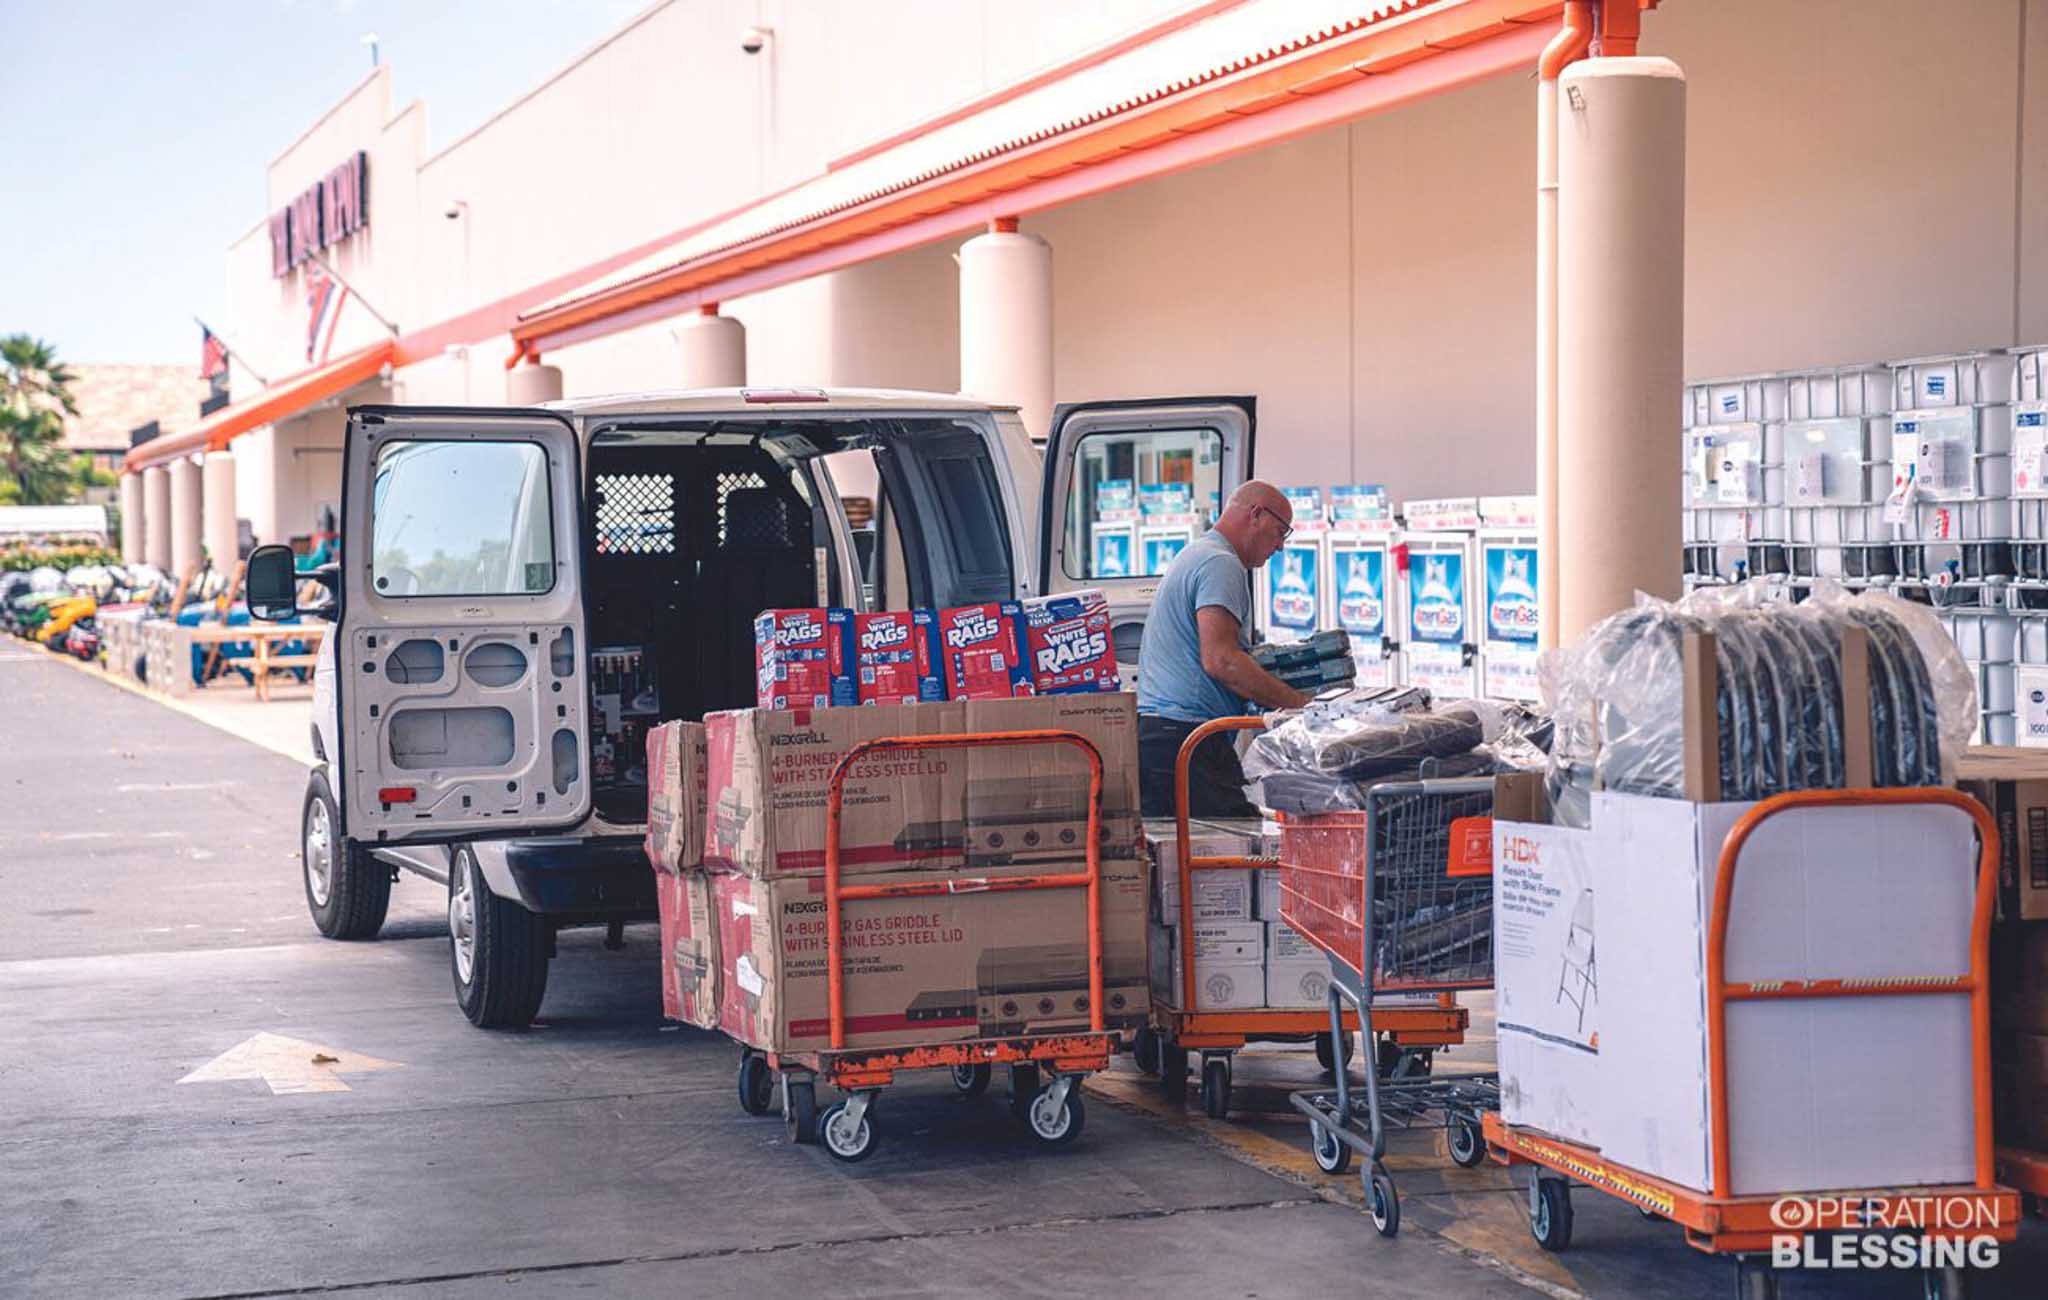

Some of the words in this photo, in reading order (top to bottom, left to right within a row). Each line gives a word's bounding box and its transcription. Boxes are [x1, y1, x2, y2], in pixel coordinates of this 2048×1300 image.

[947, 618, 999, 648] RAGS
[953, 614, 985, 628] WHITE
[775, 624, 822, 646] RAGS
[861, 625, 908, 650] RAGS
[1043, 627, 1088, 647] WHITE
[1036, 632, 1107, 674] RAGS
[770, 731, 829, 747] NEXGRILL
[772, 770, 805, 785] WITH
[885, 763, 926, 777] STEEL
[928, 761, 947, 775] LID
[1503, 836, 1541, 865] HDX
[785, 919, 851, 936] 4-BURR
[855, 917, 882, 932] GAS
[885, 914, 941, 930] GRIDDLE
[785, 938, 819, 953] WITH
[898, 931, 937, 946] STEEL
[942, 928, 963, 943] LID
